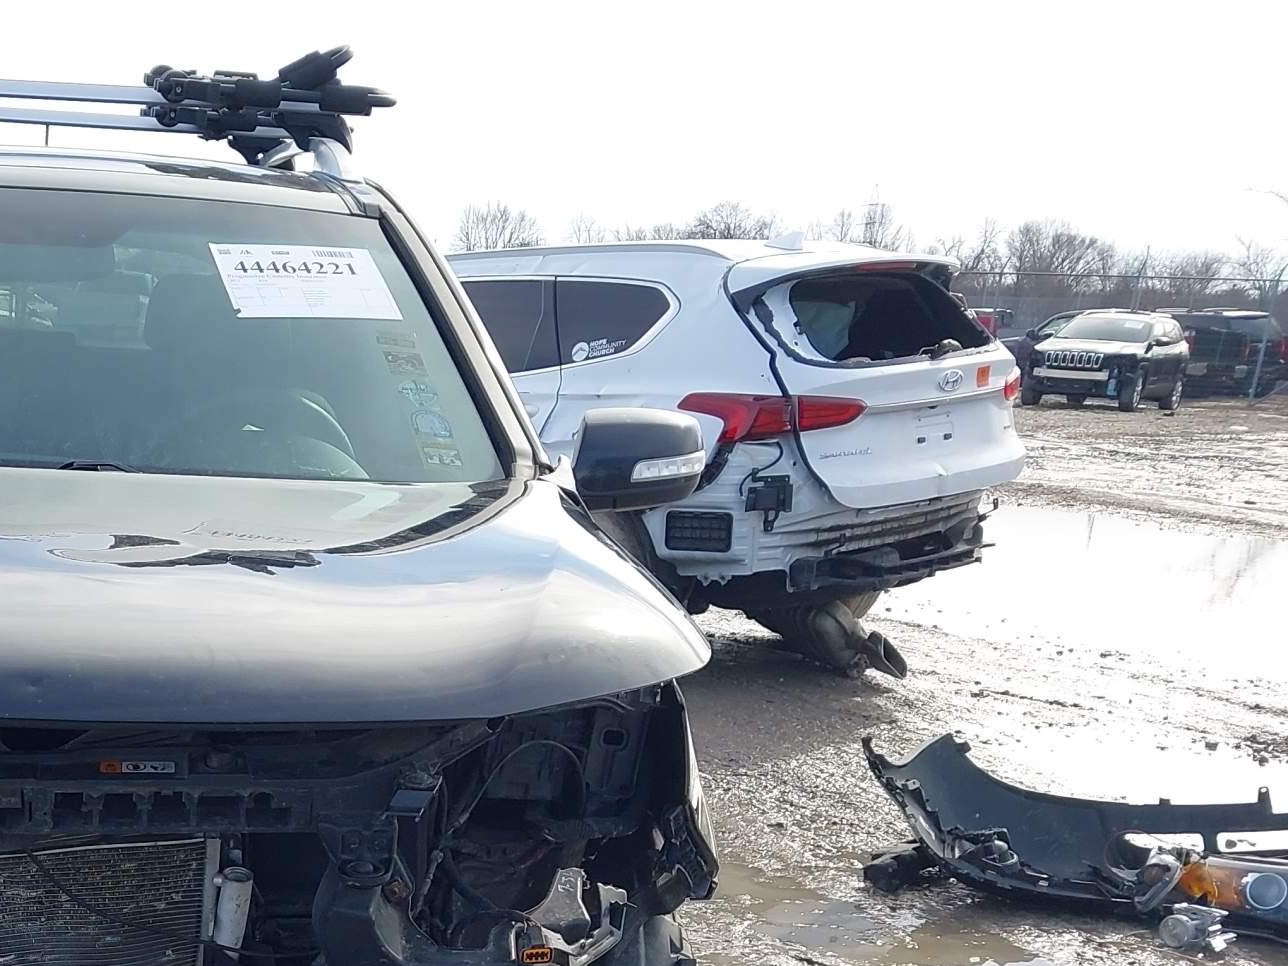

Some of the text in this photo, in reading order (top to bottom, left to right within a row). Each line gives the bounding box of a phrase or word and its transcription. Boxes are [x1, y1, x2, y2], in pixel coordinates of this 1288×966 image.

[234, 260, 357, 276] 44464221
[590, 339, 608, 347] HOPE
[590, 340, 626, 351] COMMUNITY
[589, 348, 615, 357] CHURCH
